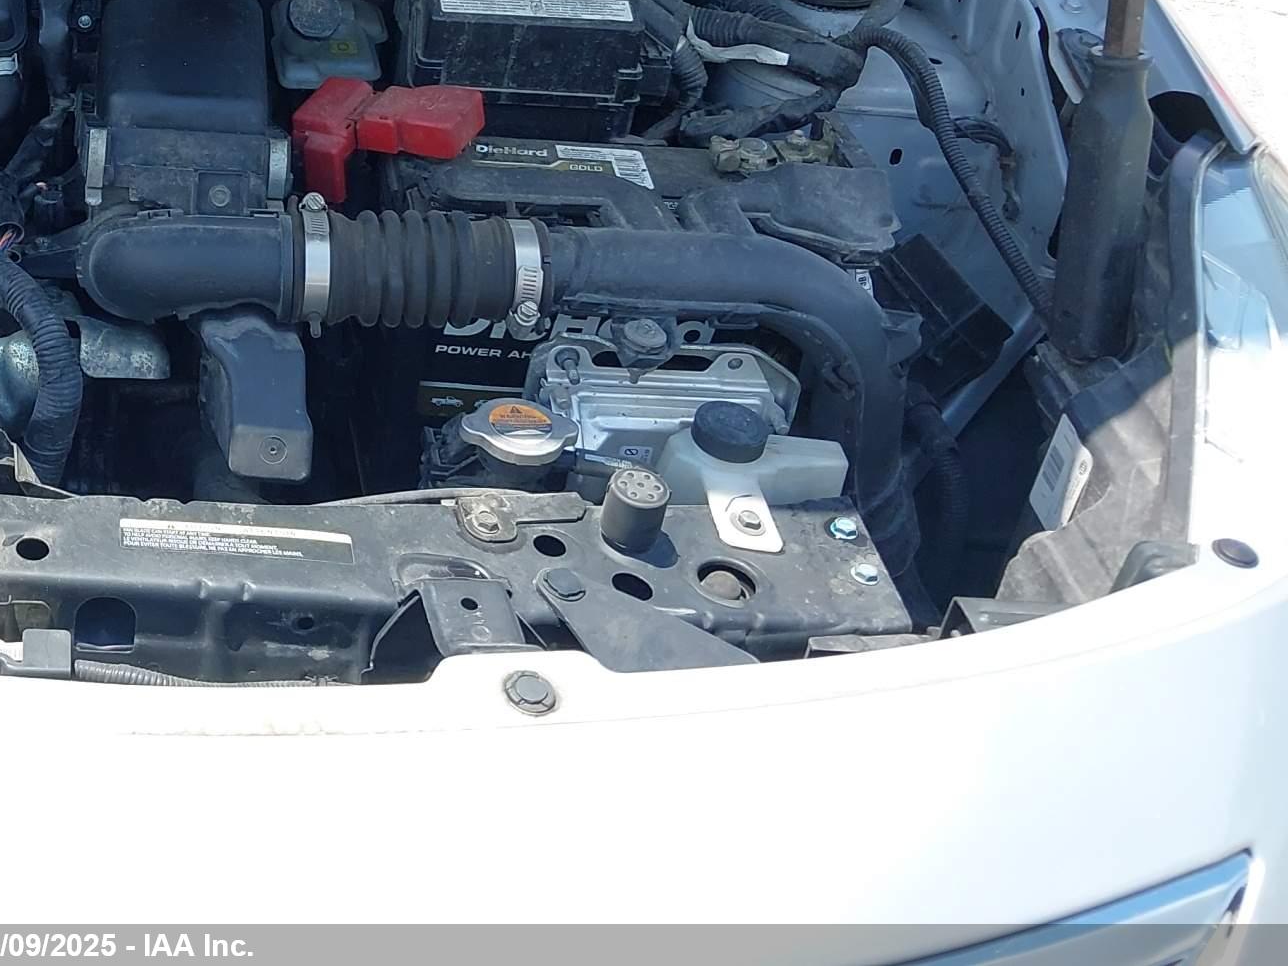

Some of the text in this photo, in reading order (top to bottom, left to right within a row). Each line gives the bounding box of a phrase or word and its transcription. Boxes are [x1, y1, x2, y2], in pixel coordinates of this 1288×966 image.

[475, 144, 548, 157] DieHard
[569, 164, 604, 172] GOLD
[435, 345, 502, 358] POWER
